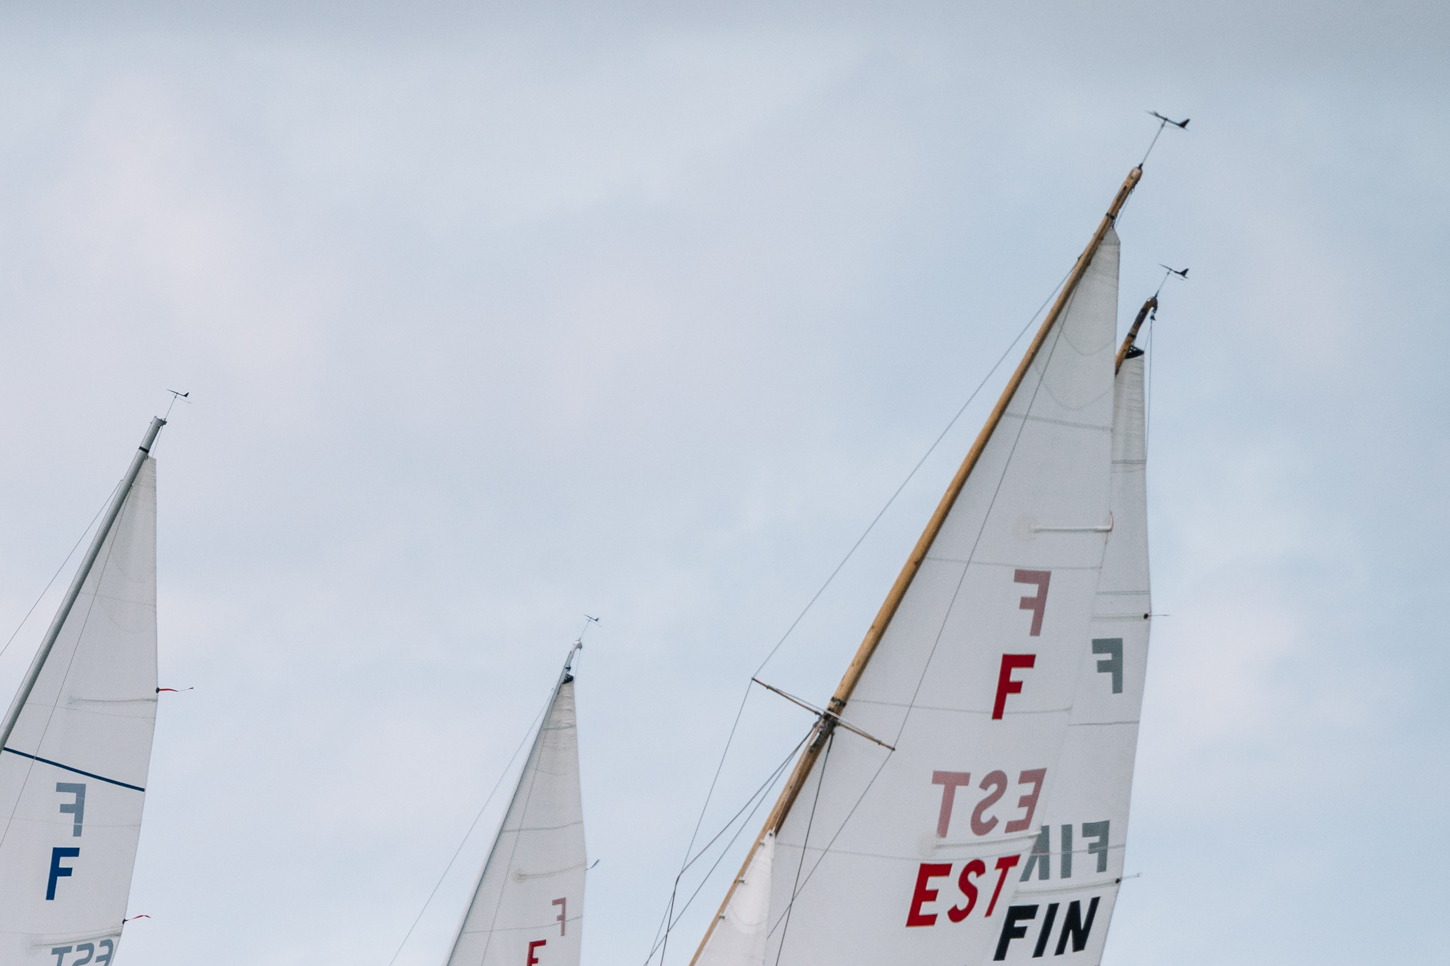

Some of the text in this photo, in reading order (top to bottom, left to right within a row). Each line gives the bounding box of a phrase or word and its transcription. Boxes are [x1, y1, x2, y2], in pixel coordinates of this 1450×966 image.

[991, 654, 1036, 720] F
[45, 847, 80, 900] F
[905, 854, 1021, 927] EST
[993, 896, 1101, 961] FIN
